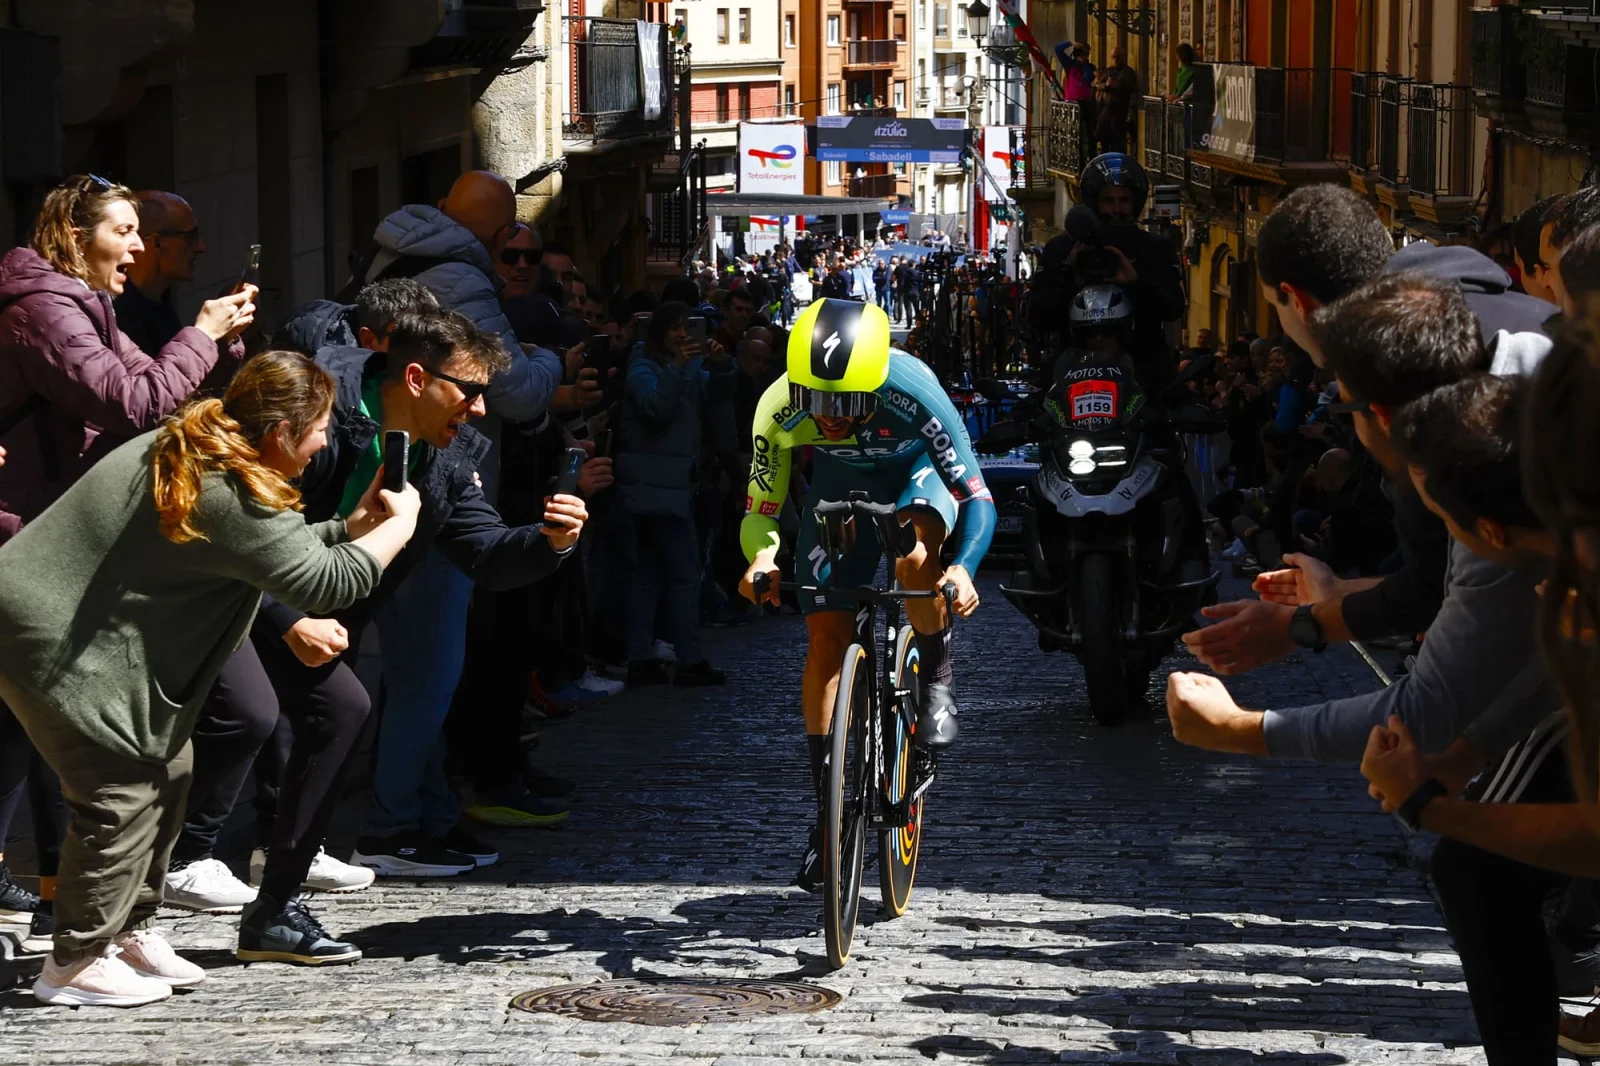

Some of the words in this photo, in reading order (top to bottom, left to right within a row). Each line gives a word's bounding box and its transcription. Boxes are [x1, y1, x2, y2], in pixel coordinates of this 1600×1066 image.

[868, 151, 912, 161] Sabadell
[748, 173, 797, 181] TotalEnergies
[1064, 367, 1103, 380] MOTOS
[1106, 366, 1122, 376] TV
[773, 401, 798, 424] BOR
[1077, 401, 1111, 414] 1159
[920, 416, 967, 483] BORA
